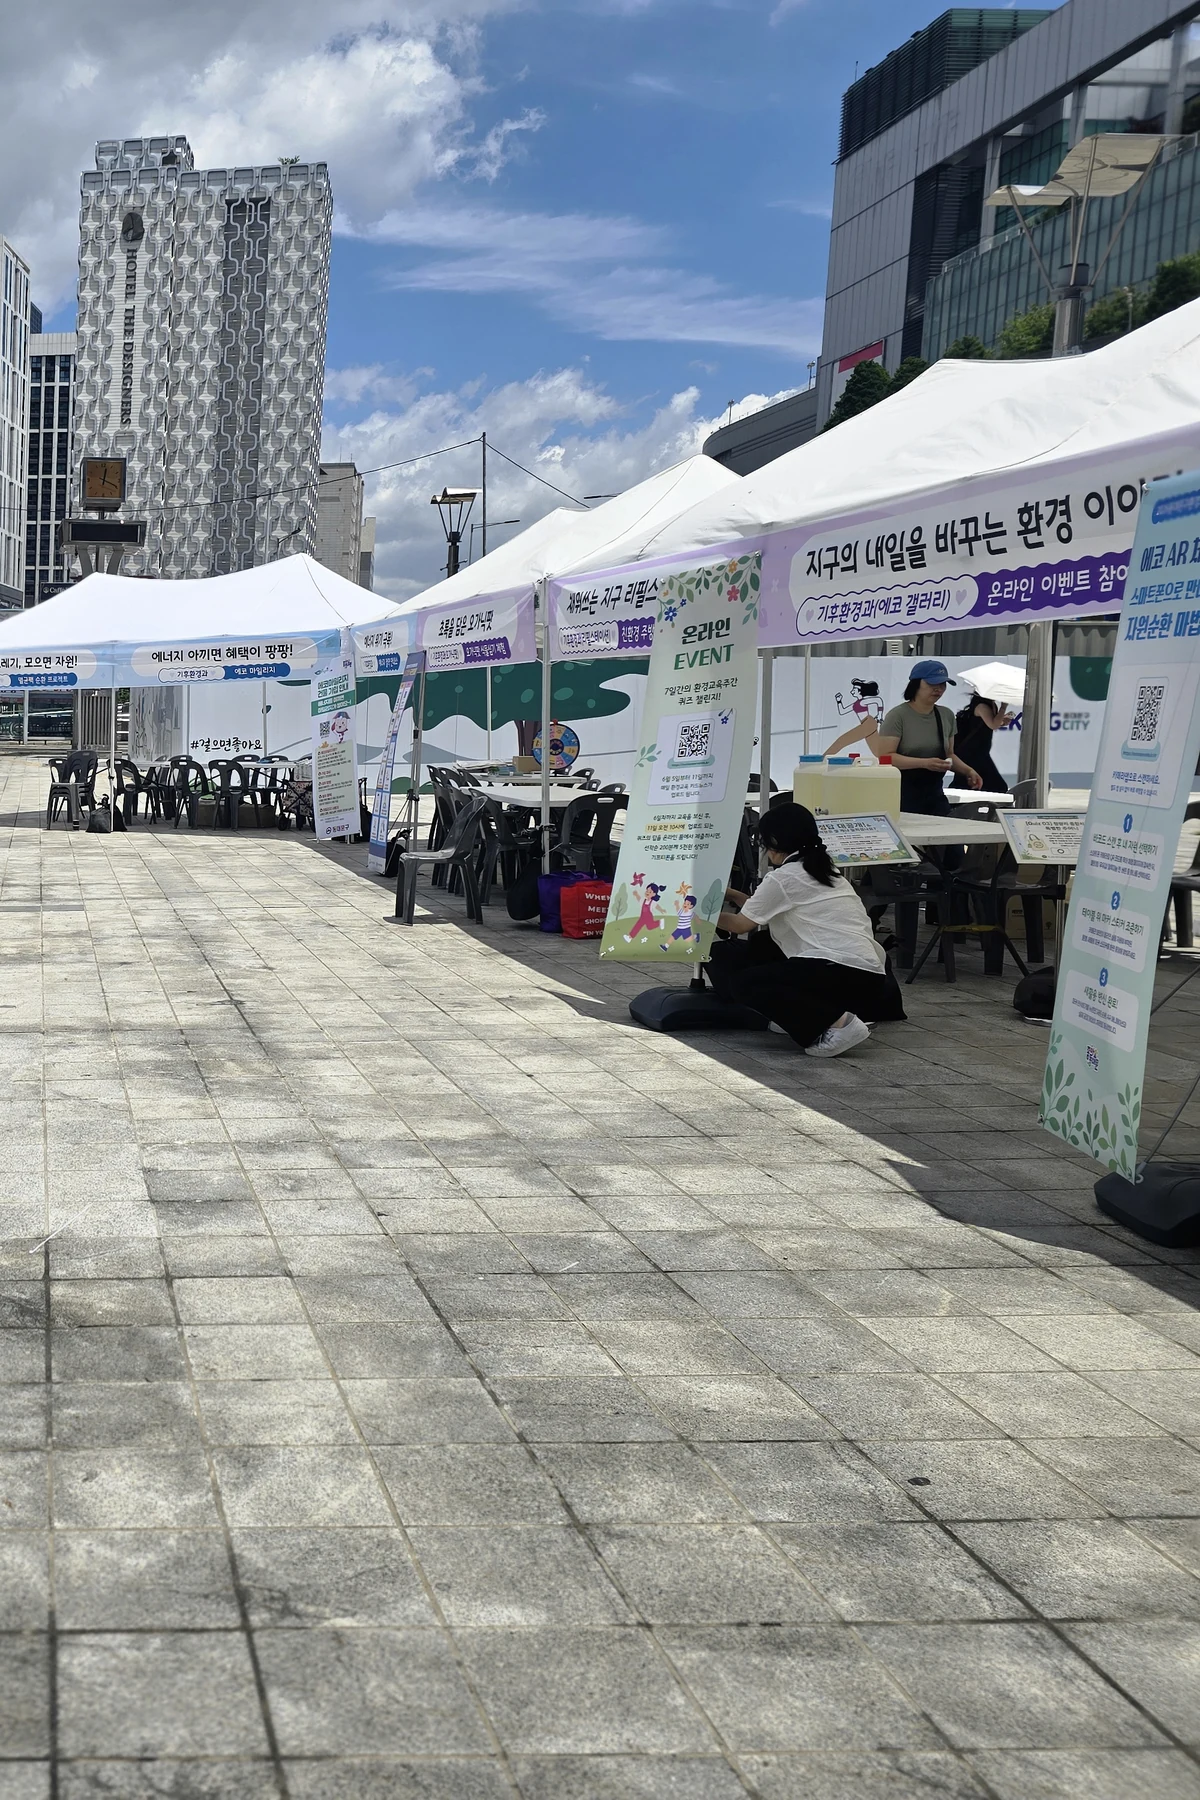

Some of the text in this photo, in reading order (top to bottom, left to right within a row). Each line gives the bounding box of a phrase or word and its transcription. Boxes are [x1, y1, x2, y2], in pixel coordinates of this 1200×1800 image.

[121, 248, 137, 425] HOTEL THE DESIGNERS
[806, 542, 859, 580] 지구의
[865, 526, 927, 572] 내일을
[935, 511, 1008, 558] 바꾸는
[1017, 494, 1073, 549] 환경
[1140, 540, 1189, 572] 에코 AR
[567, 578, 659, 615] 채워쓰는 지구 리필스
[987, 577, 1034, 606] 온라인
[1041, 569, 1091, 597] 이벤트
[1129, 581, 1185, 605] 스마트폰으로
[817, 589, 951, 624] 기후환경과(에코 갤러리)
[438, 610, 494, 639] 초록을 담은 오가닉팟
[621, 624, 639, 643] 친환경
[681, 617, 731, 645] 온라인
[1125, 612, 1173, 641] 자원순환
[24, 656, 52, 669] 모으면
[55, 655, 78, 668] 자원!
[151, 644, 293, 662] 에너지 아끼면 혜택이 팡팡!
[674, 644, 734, 670] EVENT
[35, 676, 46, 684] 순환
[177, 670, 208, 678] 기후환경과
[234, 666, 276, 675] 에코 마일리지
[664, 677, 738, 696] 7일간의 환경교육주간
[678, 693, 721, 705] 퀴즈 챌린지!
[1063, 720, 1090, 730] CITY
[190, 737, 263, 752] #걸으면좋아요
[1126, 818, 1130, 830] 1
[1113, 896, 1118, 907] 2
[1101, 972, 1106, 983] 3
